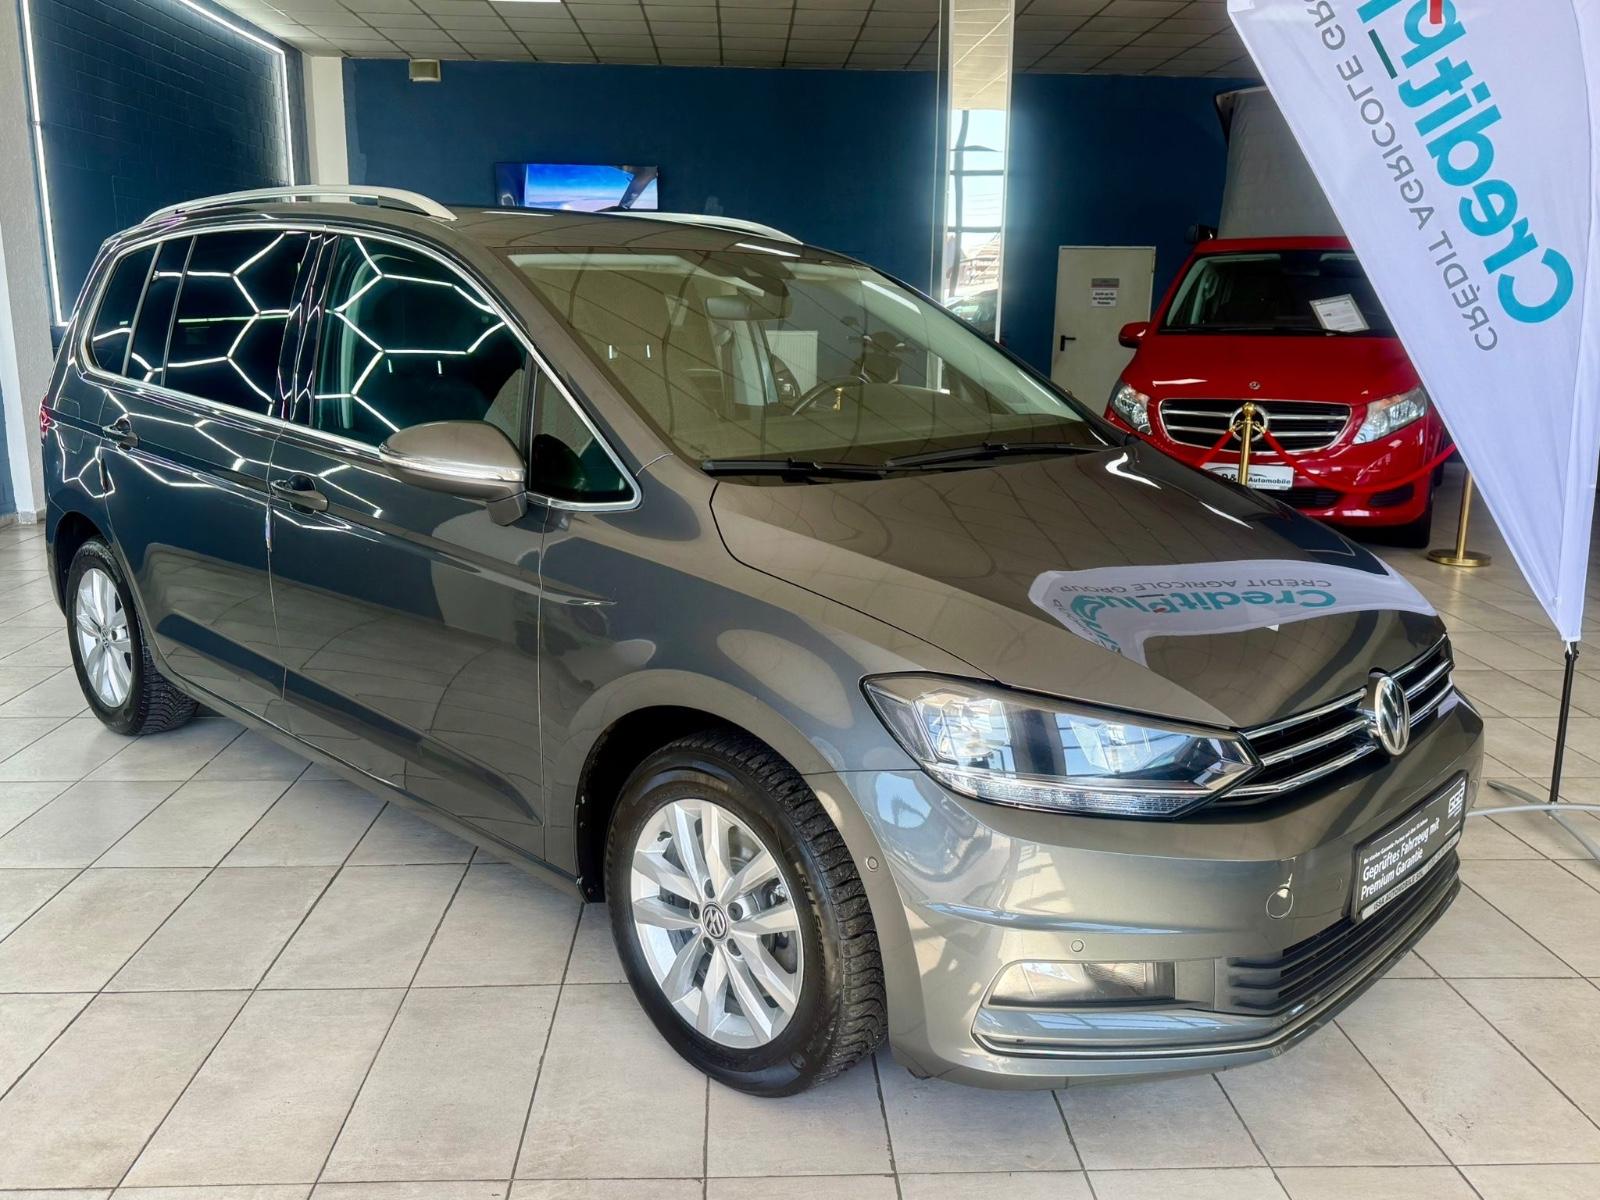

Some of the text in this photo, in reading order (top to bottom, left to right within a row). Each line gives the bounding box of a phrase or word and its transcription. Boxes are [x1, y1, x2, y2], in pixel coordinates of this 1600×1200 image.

[1248, 476, 1291, 484] Automobile
[1131, 580, 1237, 591] AGRICOLE
[1400, 827, 1429, 857] Fahrzeug
[1360, 870, 1395, 901] Premium
[1395, 847, 1423, 876] Garantie
